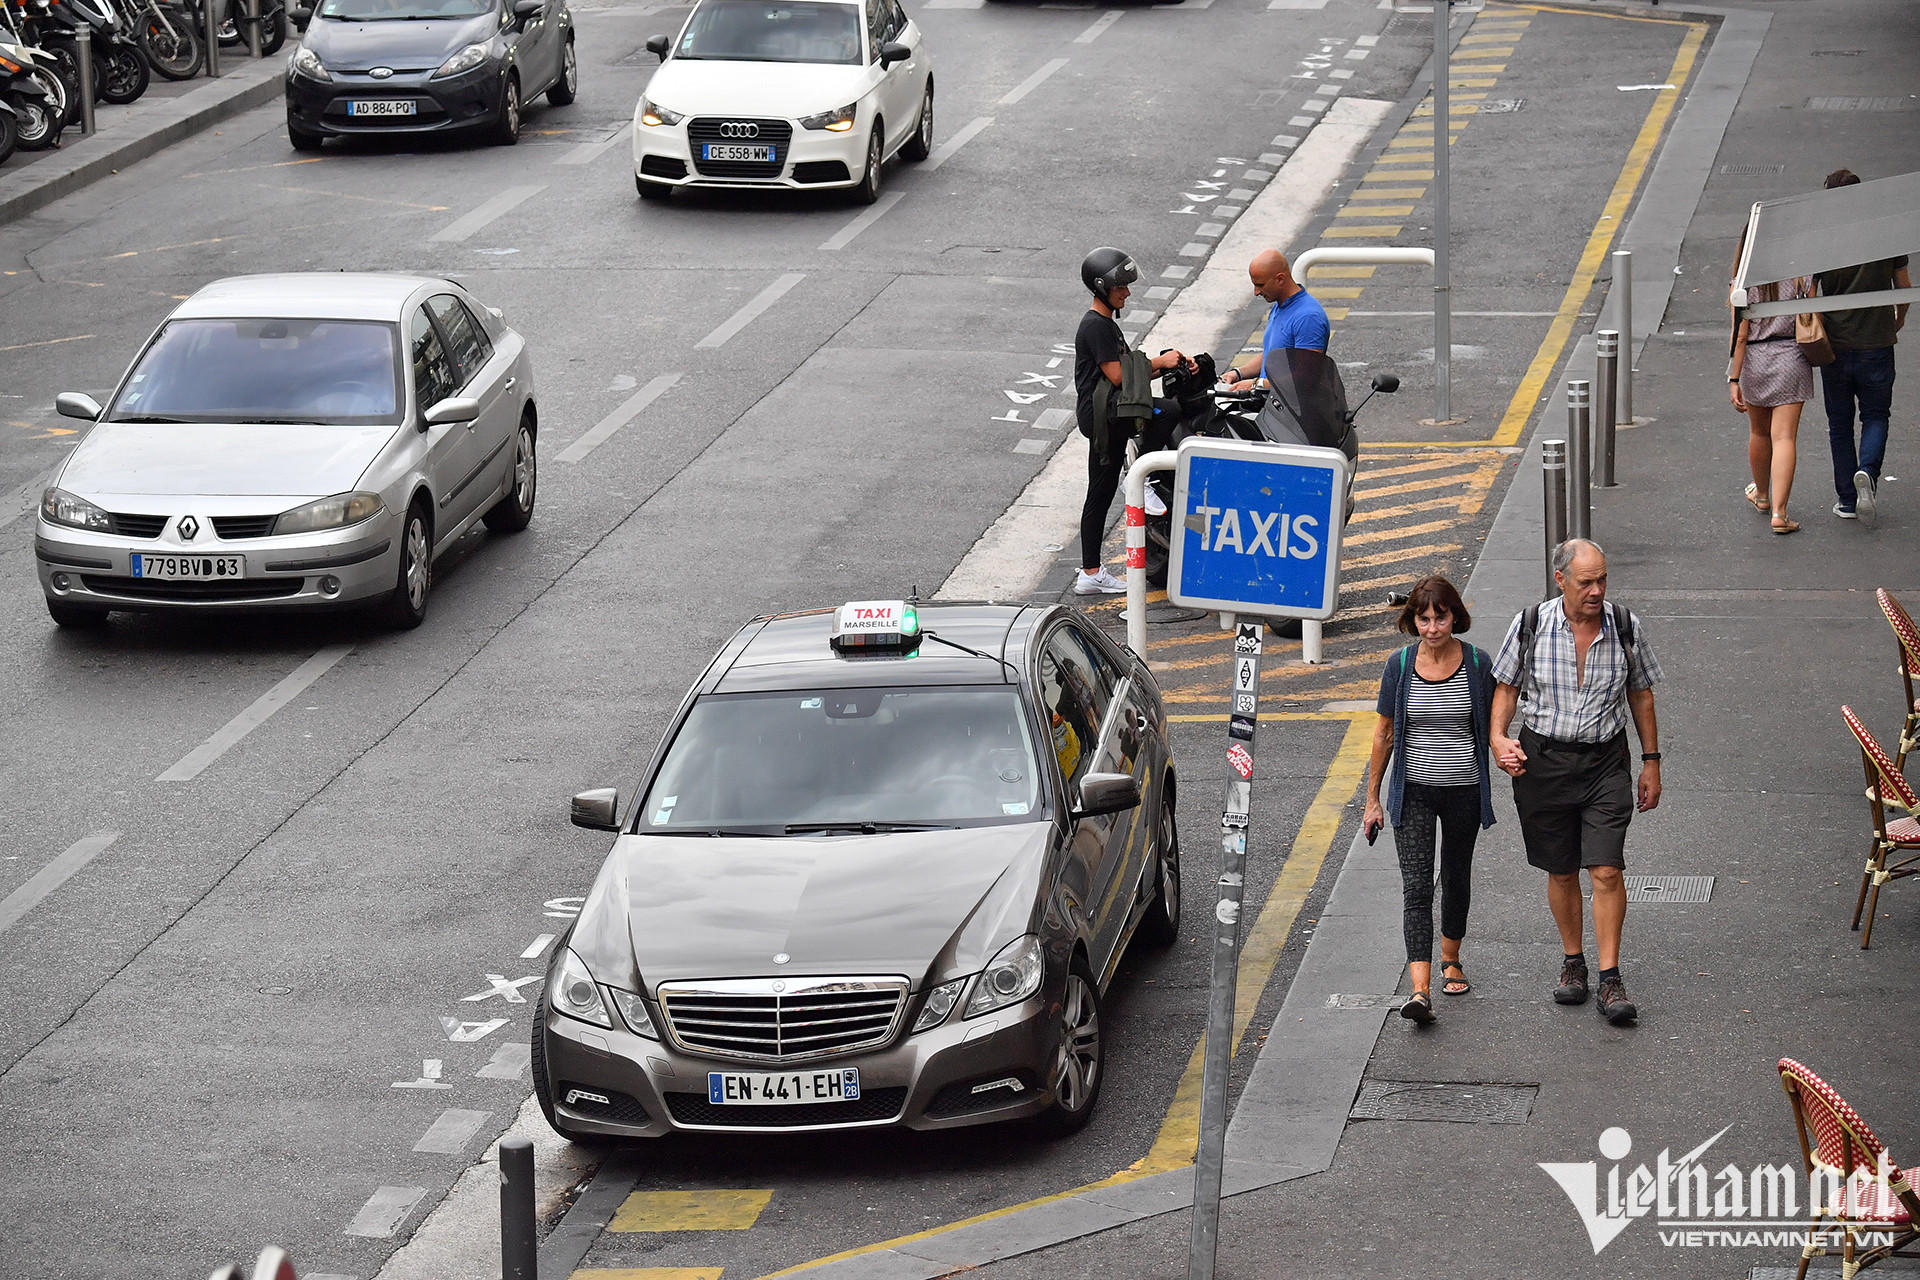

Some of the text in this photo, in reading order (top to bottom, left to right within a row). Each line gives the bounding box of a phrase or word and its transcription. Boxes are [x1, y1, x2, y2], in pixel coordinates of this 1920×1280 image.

[1195, 505, 1319, 560] TAXIS
[854, 607, 892, 619] TAXI
[844, 620, 898, 629] MARSEILLE
[725, 1073, 842, 1100] EN-441-EH
[845, 1085, 858, 1098] 2B
